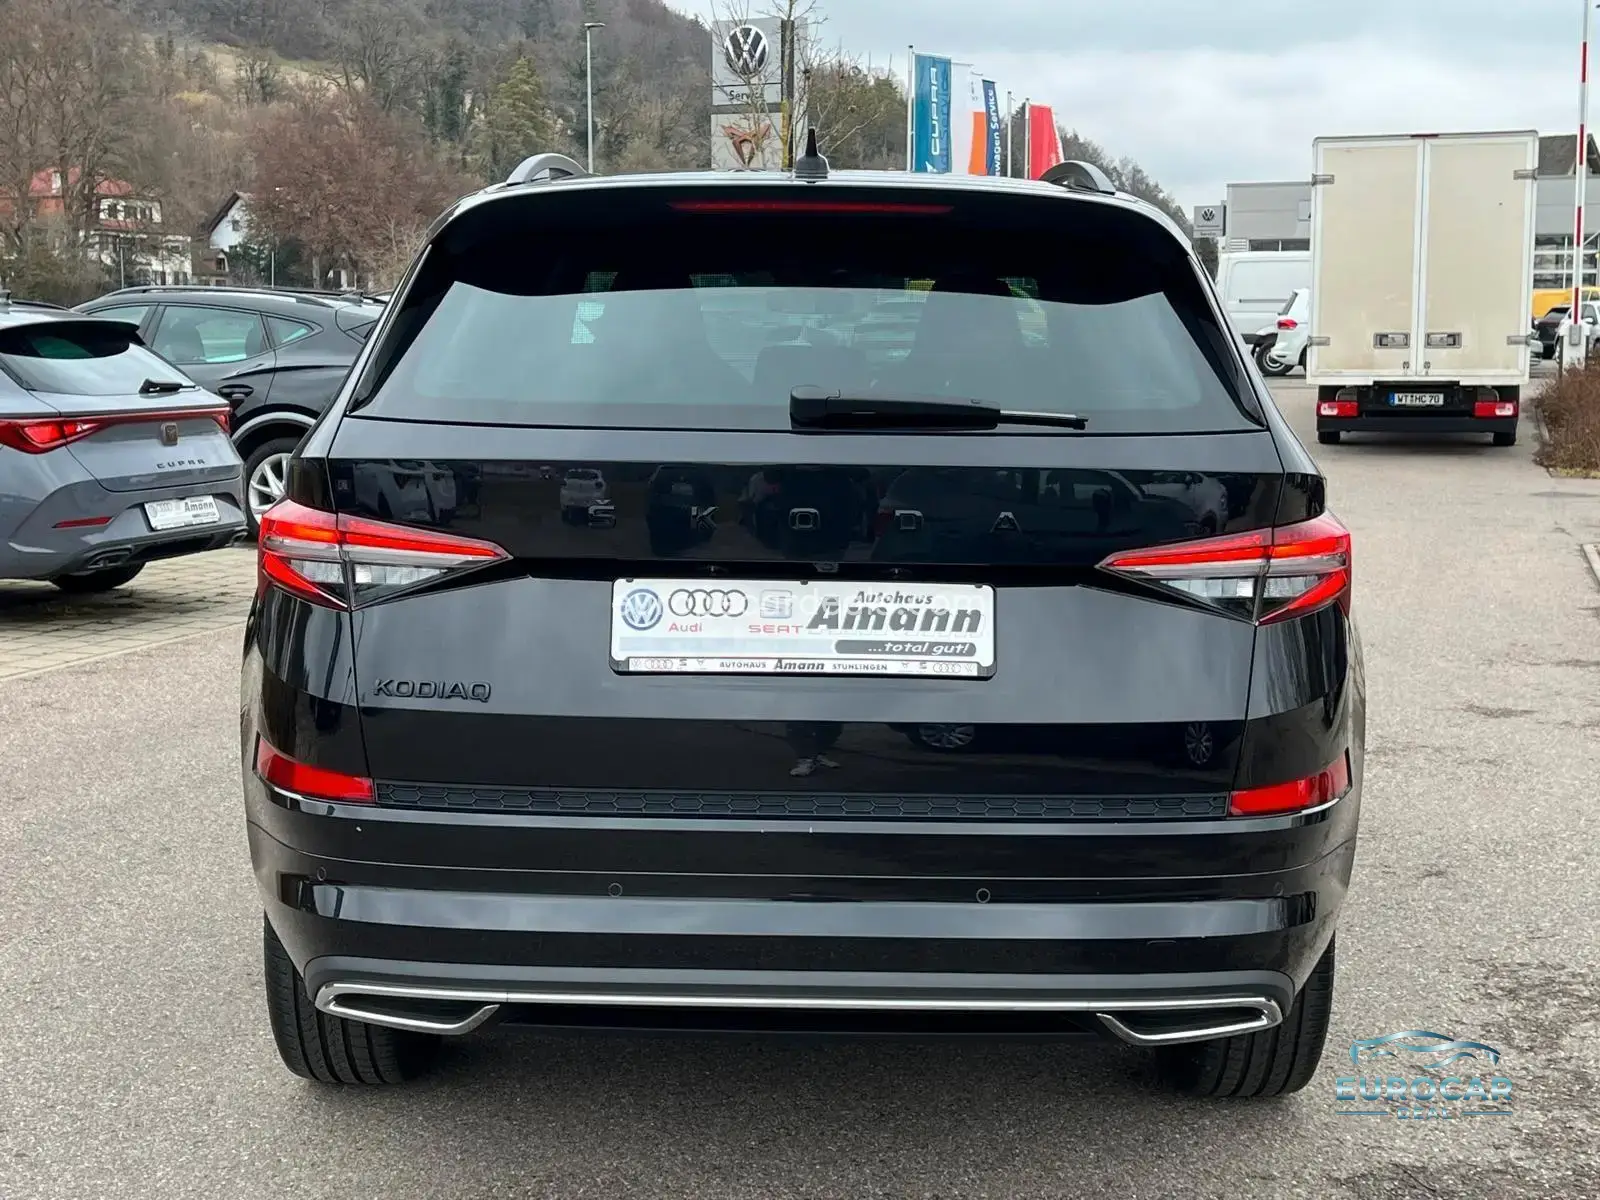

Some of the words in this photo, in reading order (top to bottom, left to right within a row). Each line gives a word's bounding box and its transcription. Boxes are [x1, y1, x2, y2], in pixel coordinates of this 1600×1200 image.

[930, 67, 940, 155] CUPRA
[987, 89, 1000, 130] Service
[853, 591, 934, 605] Autohaus
[806, 597, 984, 634] Amann
[668, 622, 703, 633] Audi
[748, 624, 803, 634] SEAT
[931, 643, 970, 656] gut!
[719, 661, 767, 669] AUTOHAUS
[773, 658, 825, 671] Amann
[373, 679, 492, 703] KODIAQ
